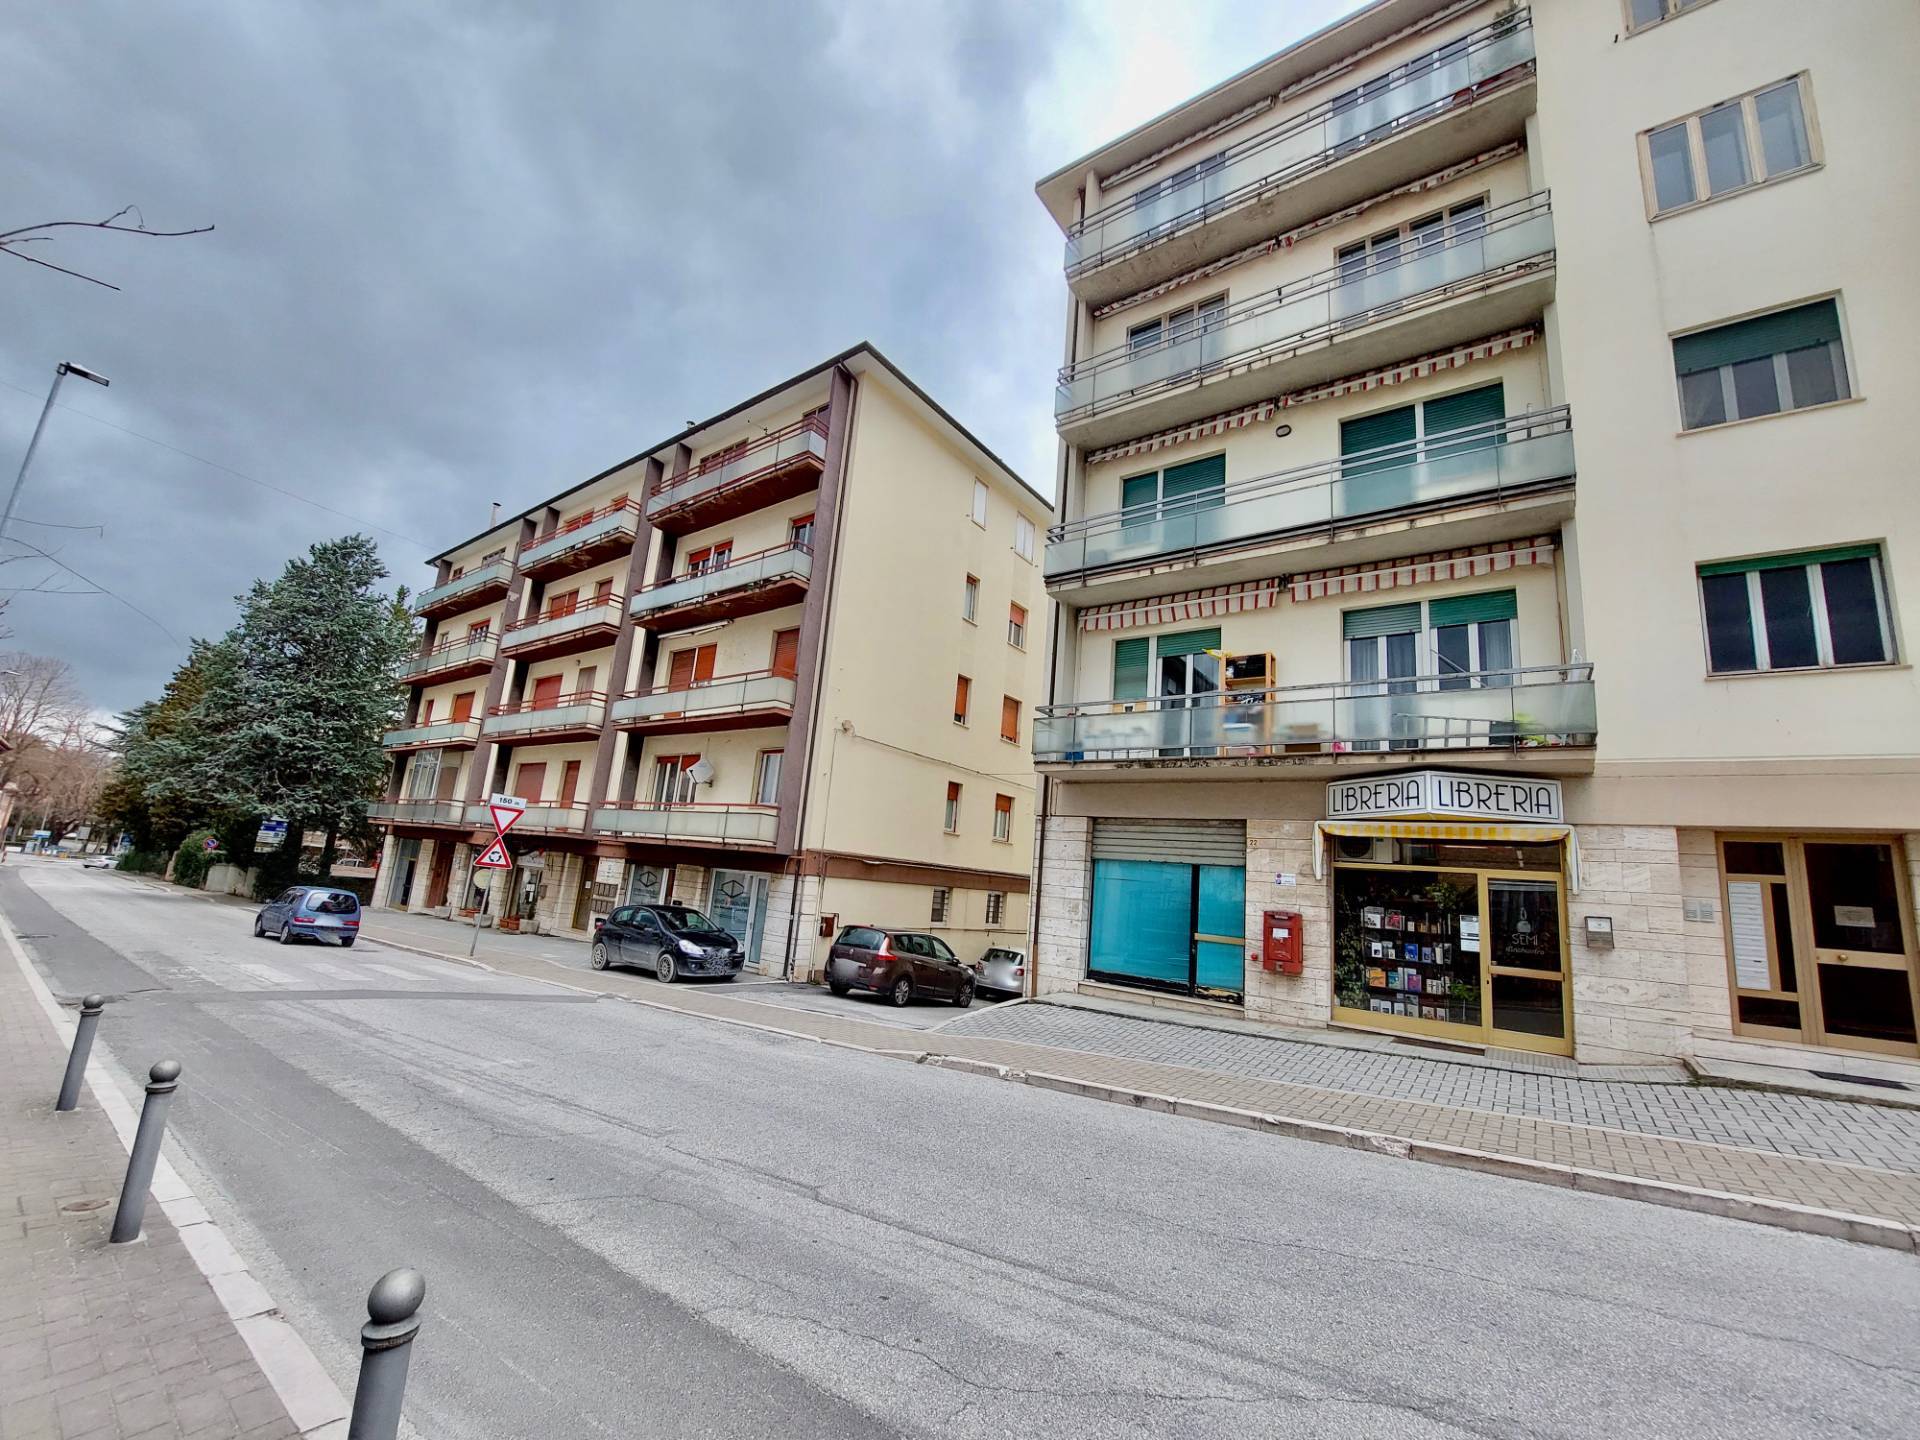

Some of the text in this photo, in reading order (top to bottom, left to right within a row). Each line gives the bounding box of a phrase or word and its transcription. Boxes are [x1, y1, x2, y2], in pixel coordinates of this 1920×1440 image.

[499, 797, 513, 805] 150
[1332, 780, 1420, 812] LIBRERIA
[1438, 780, 1552, 814] LIBRERIA
[1511, 932, 1538, 946] SEMI
